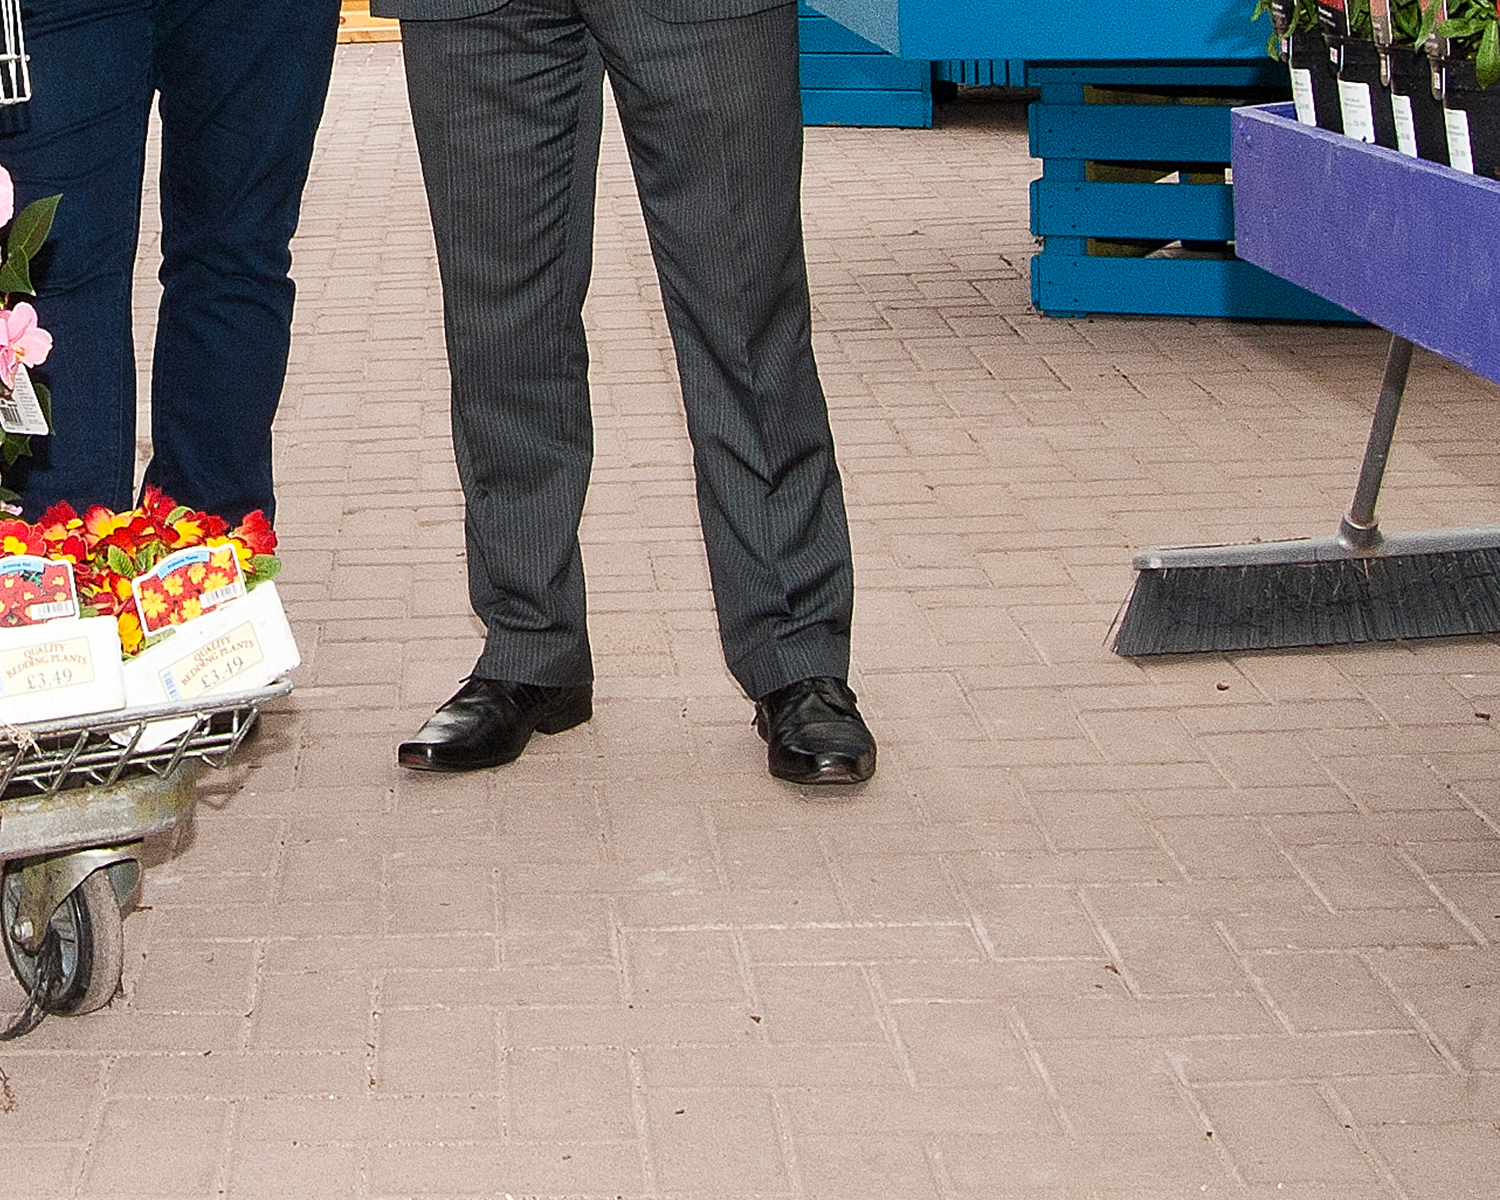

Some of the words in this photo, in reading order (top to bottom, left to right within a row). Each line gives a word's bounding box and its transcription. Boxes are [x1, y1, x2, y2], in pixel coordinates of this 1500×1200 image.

[24, 643, 66, 660] QUALITY
[194, 635, 231, 661] QUALITY
[6, 656, 49, 679] BEDDING
[51, 653, 88, 665] PLANTS
[181, 654, 219, 686] BEDDING
[220, 640, 254, 657] PLANTS
[201, 656, 244, 688] £3.49
[26, 668, 72, 689] £3.49
